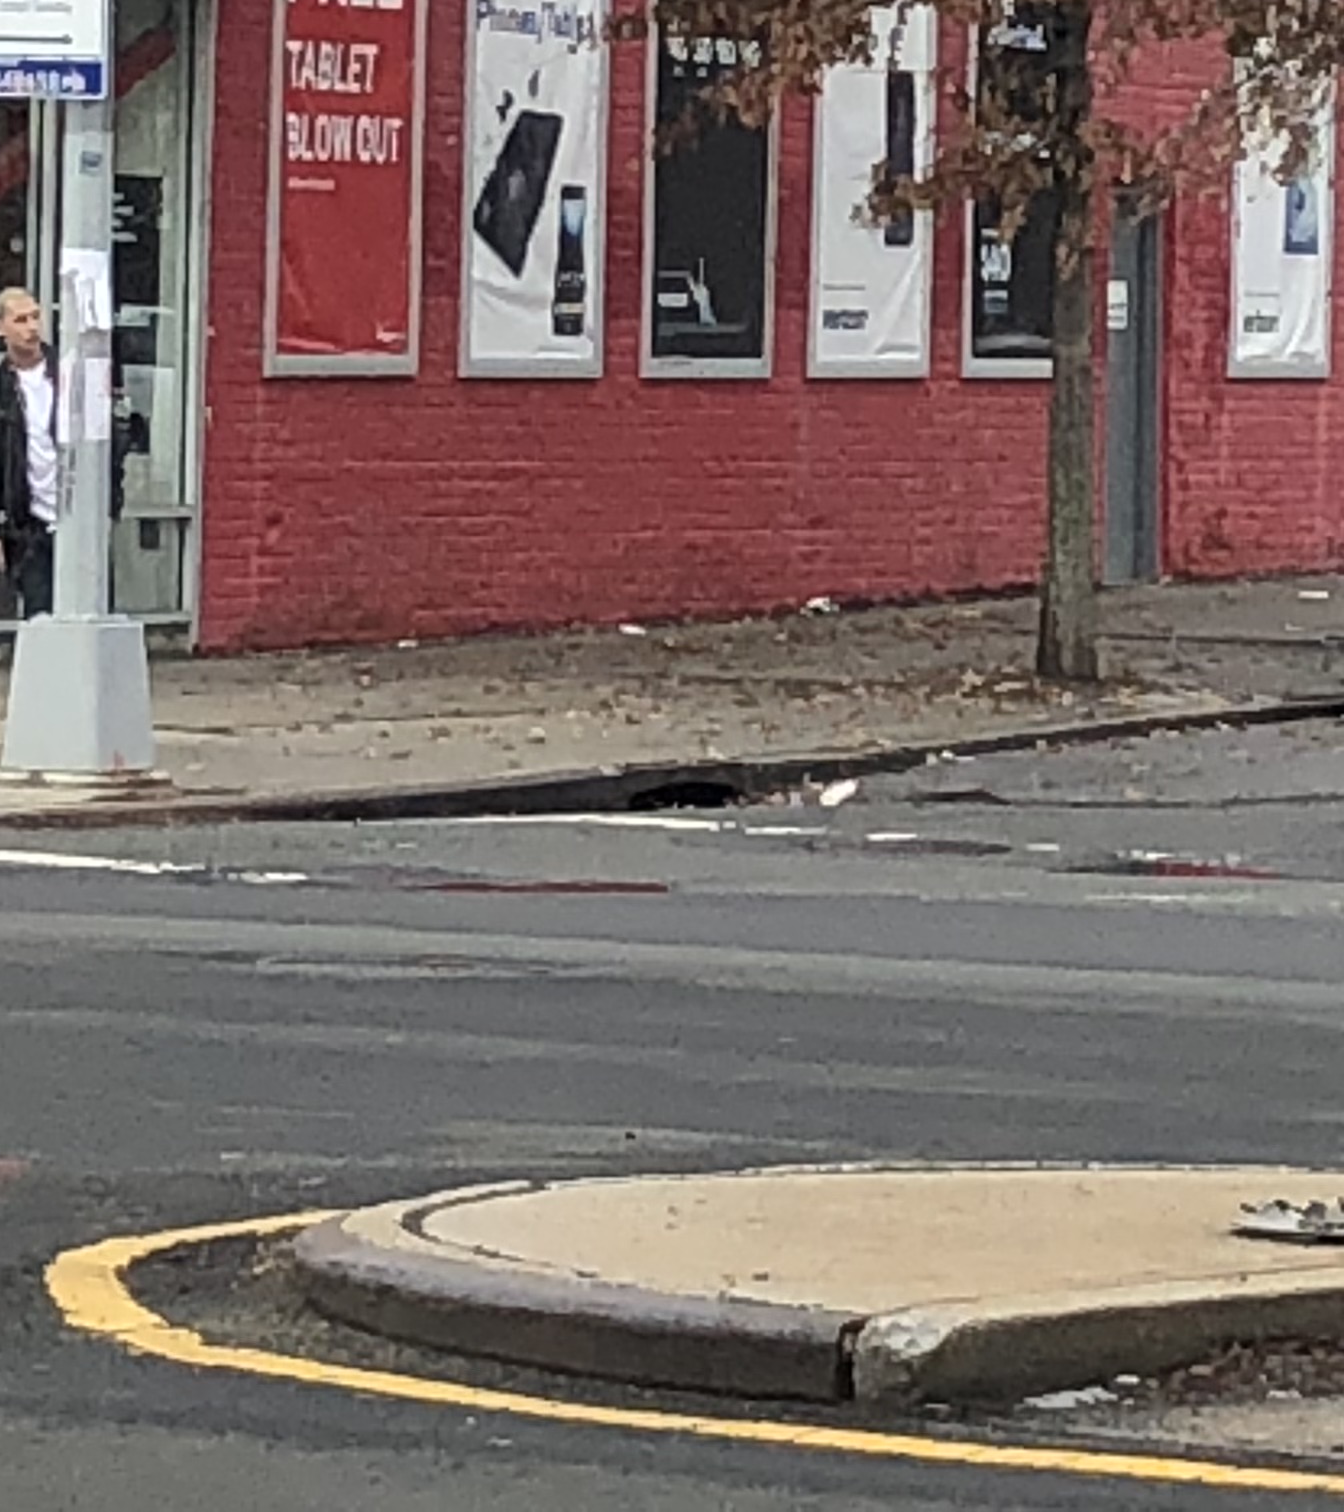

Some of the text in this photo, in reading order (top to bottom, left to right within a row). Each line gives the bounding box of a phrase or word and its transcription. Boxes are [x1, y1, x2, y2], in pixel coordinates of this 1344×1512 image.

[285, 40, 379, 94] TABLET
[286, 111, 404, 165] BLOW OUT
